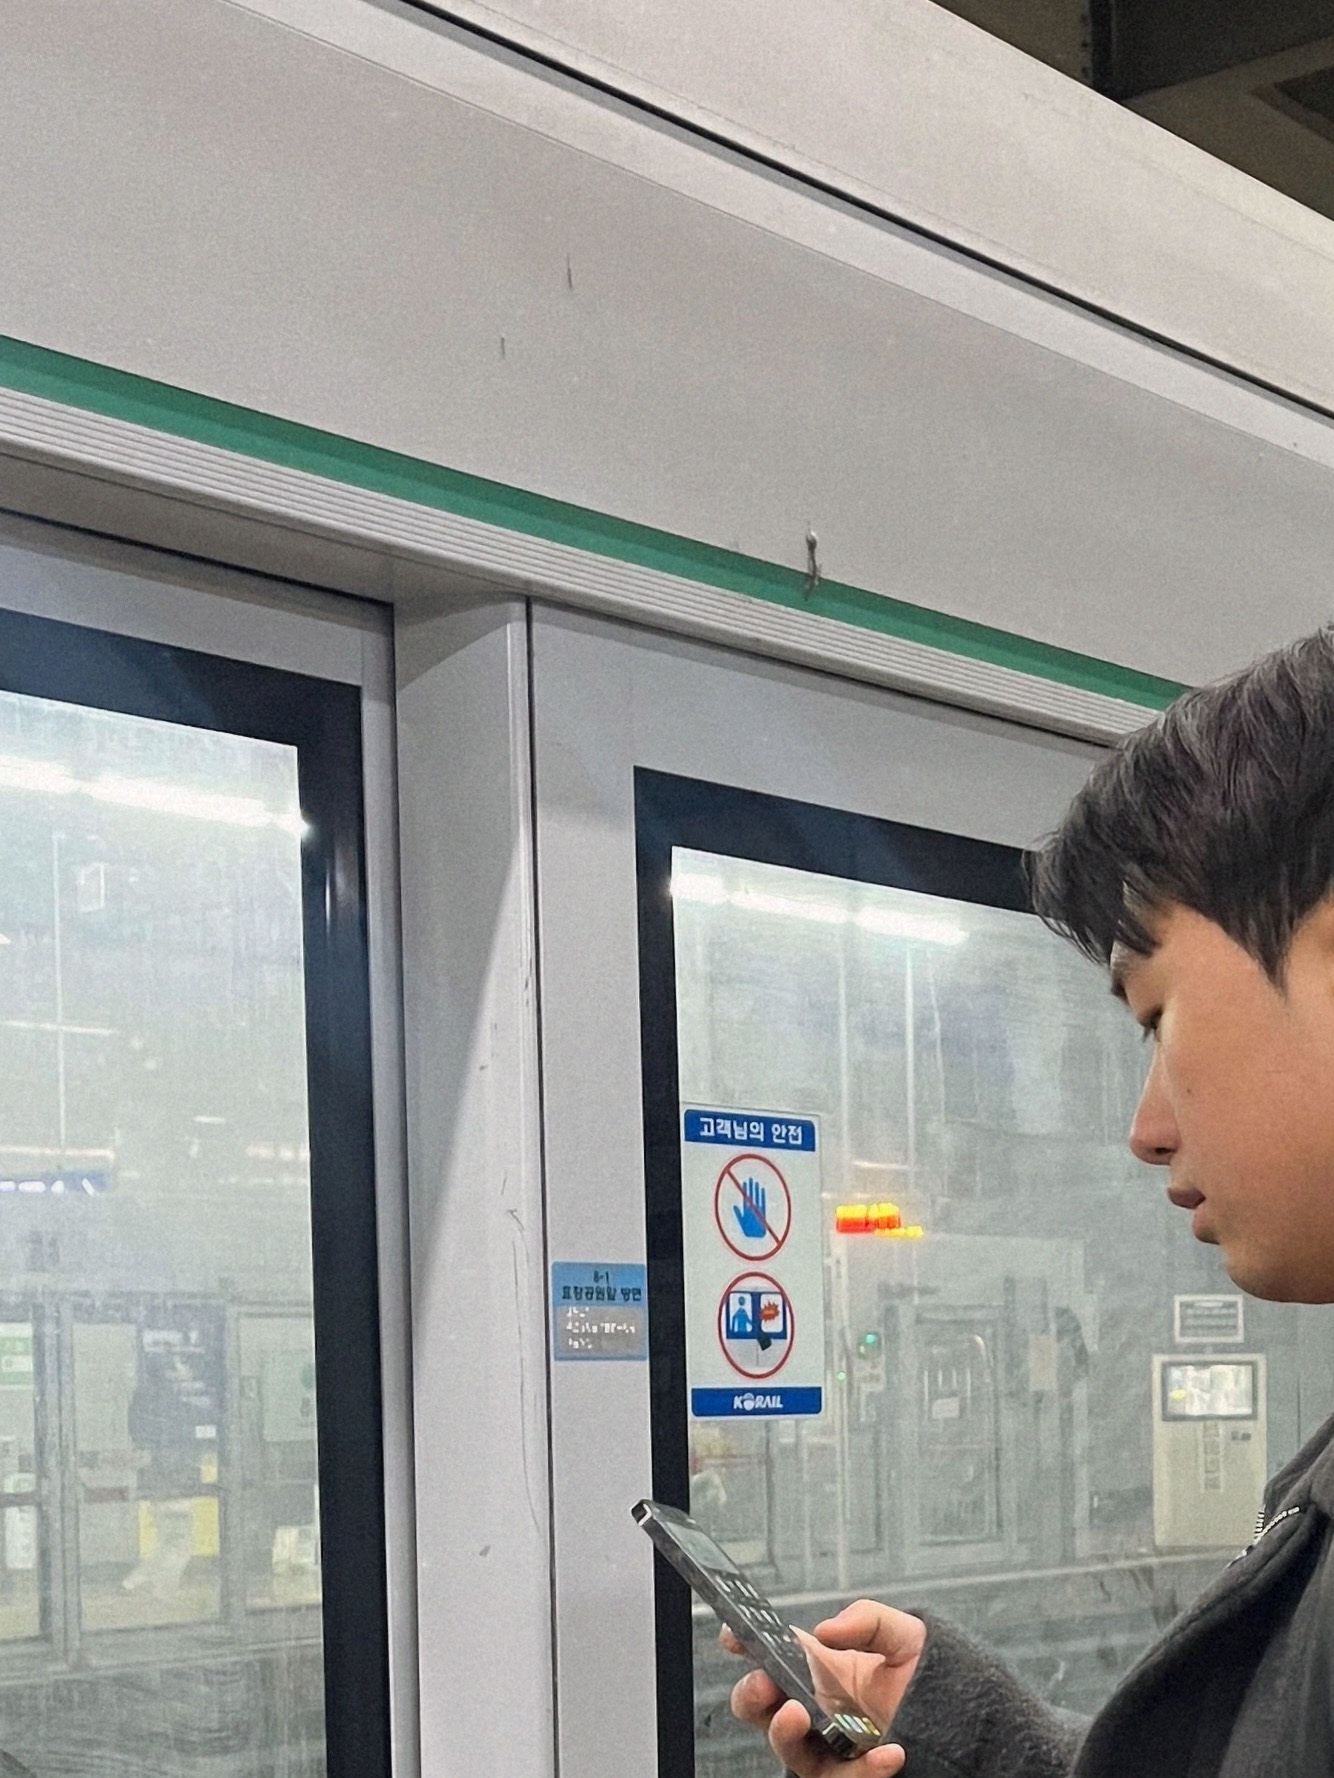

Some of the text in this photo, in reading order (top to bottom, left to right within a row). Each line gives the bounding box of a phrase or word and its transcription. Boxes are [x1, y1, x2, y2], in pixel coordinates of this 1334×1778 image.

[699, 1116, 803, 1146] 고객님의 안전
[620, 1287, 642, 1302] 방면
[732, 1391, 784, 1412] KORAIL
